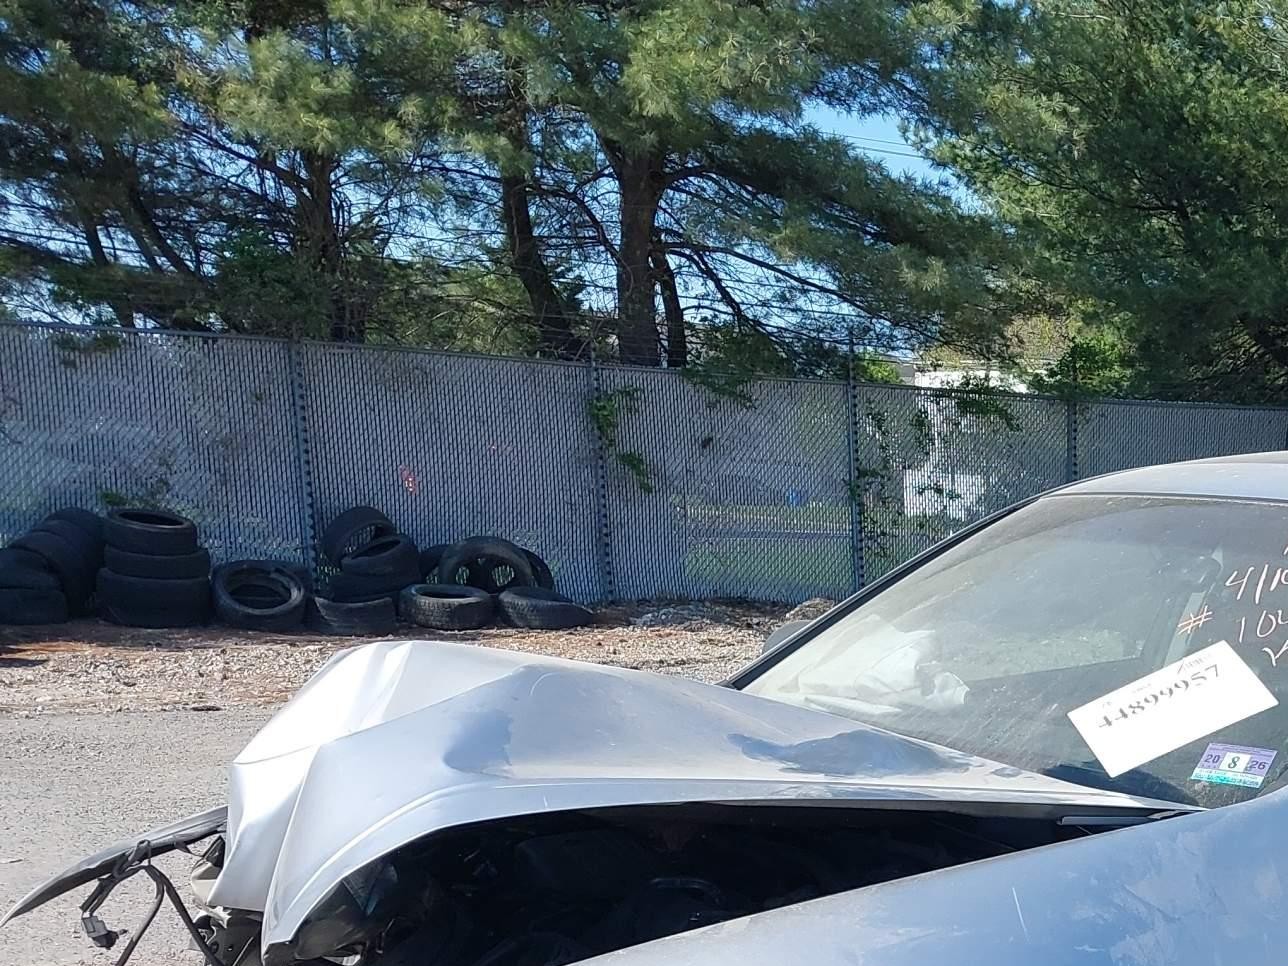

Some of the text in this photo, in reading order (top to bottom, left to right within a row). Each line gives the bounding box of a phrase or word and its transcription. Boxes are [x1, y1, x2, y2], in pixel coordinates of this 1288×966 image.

[1177, 605, 1213, 634] #
[1204, 754, 1220, 763] 20
[1227, 756, 1240, 769] 8
[1249, 760, 1267, 770] 26
